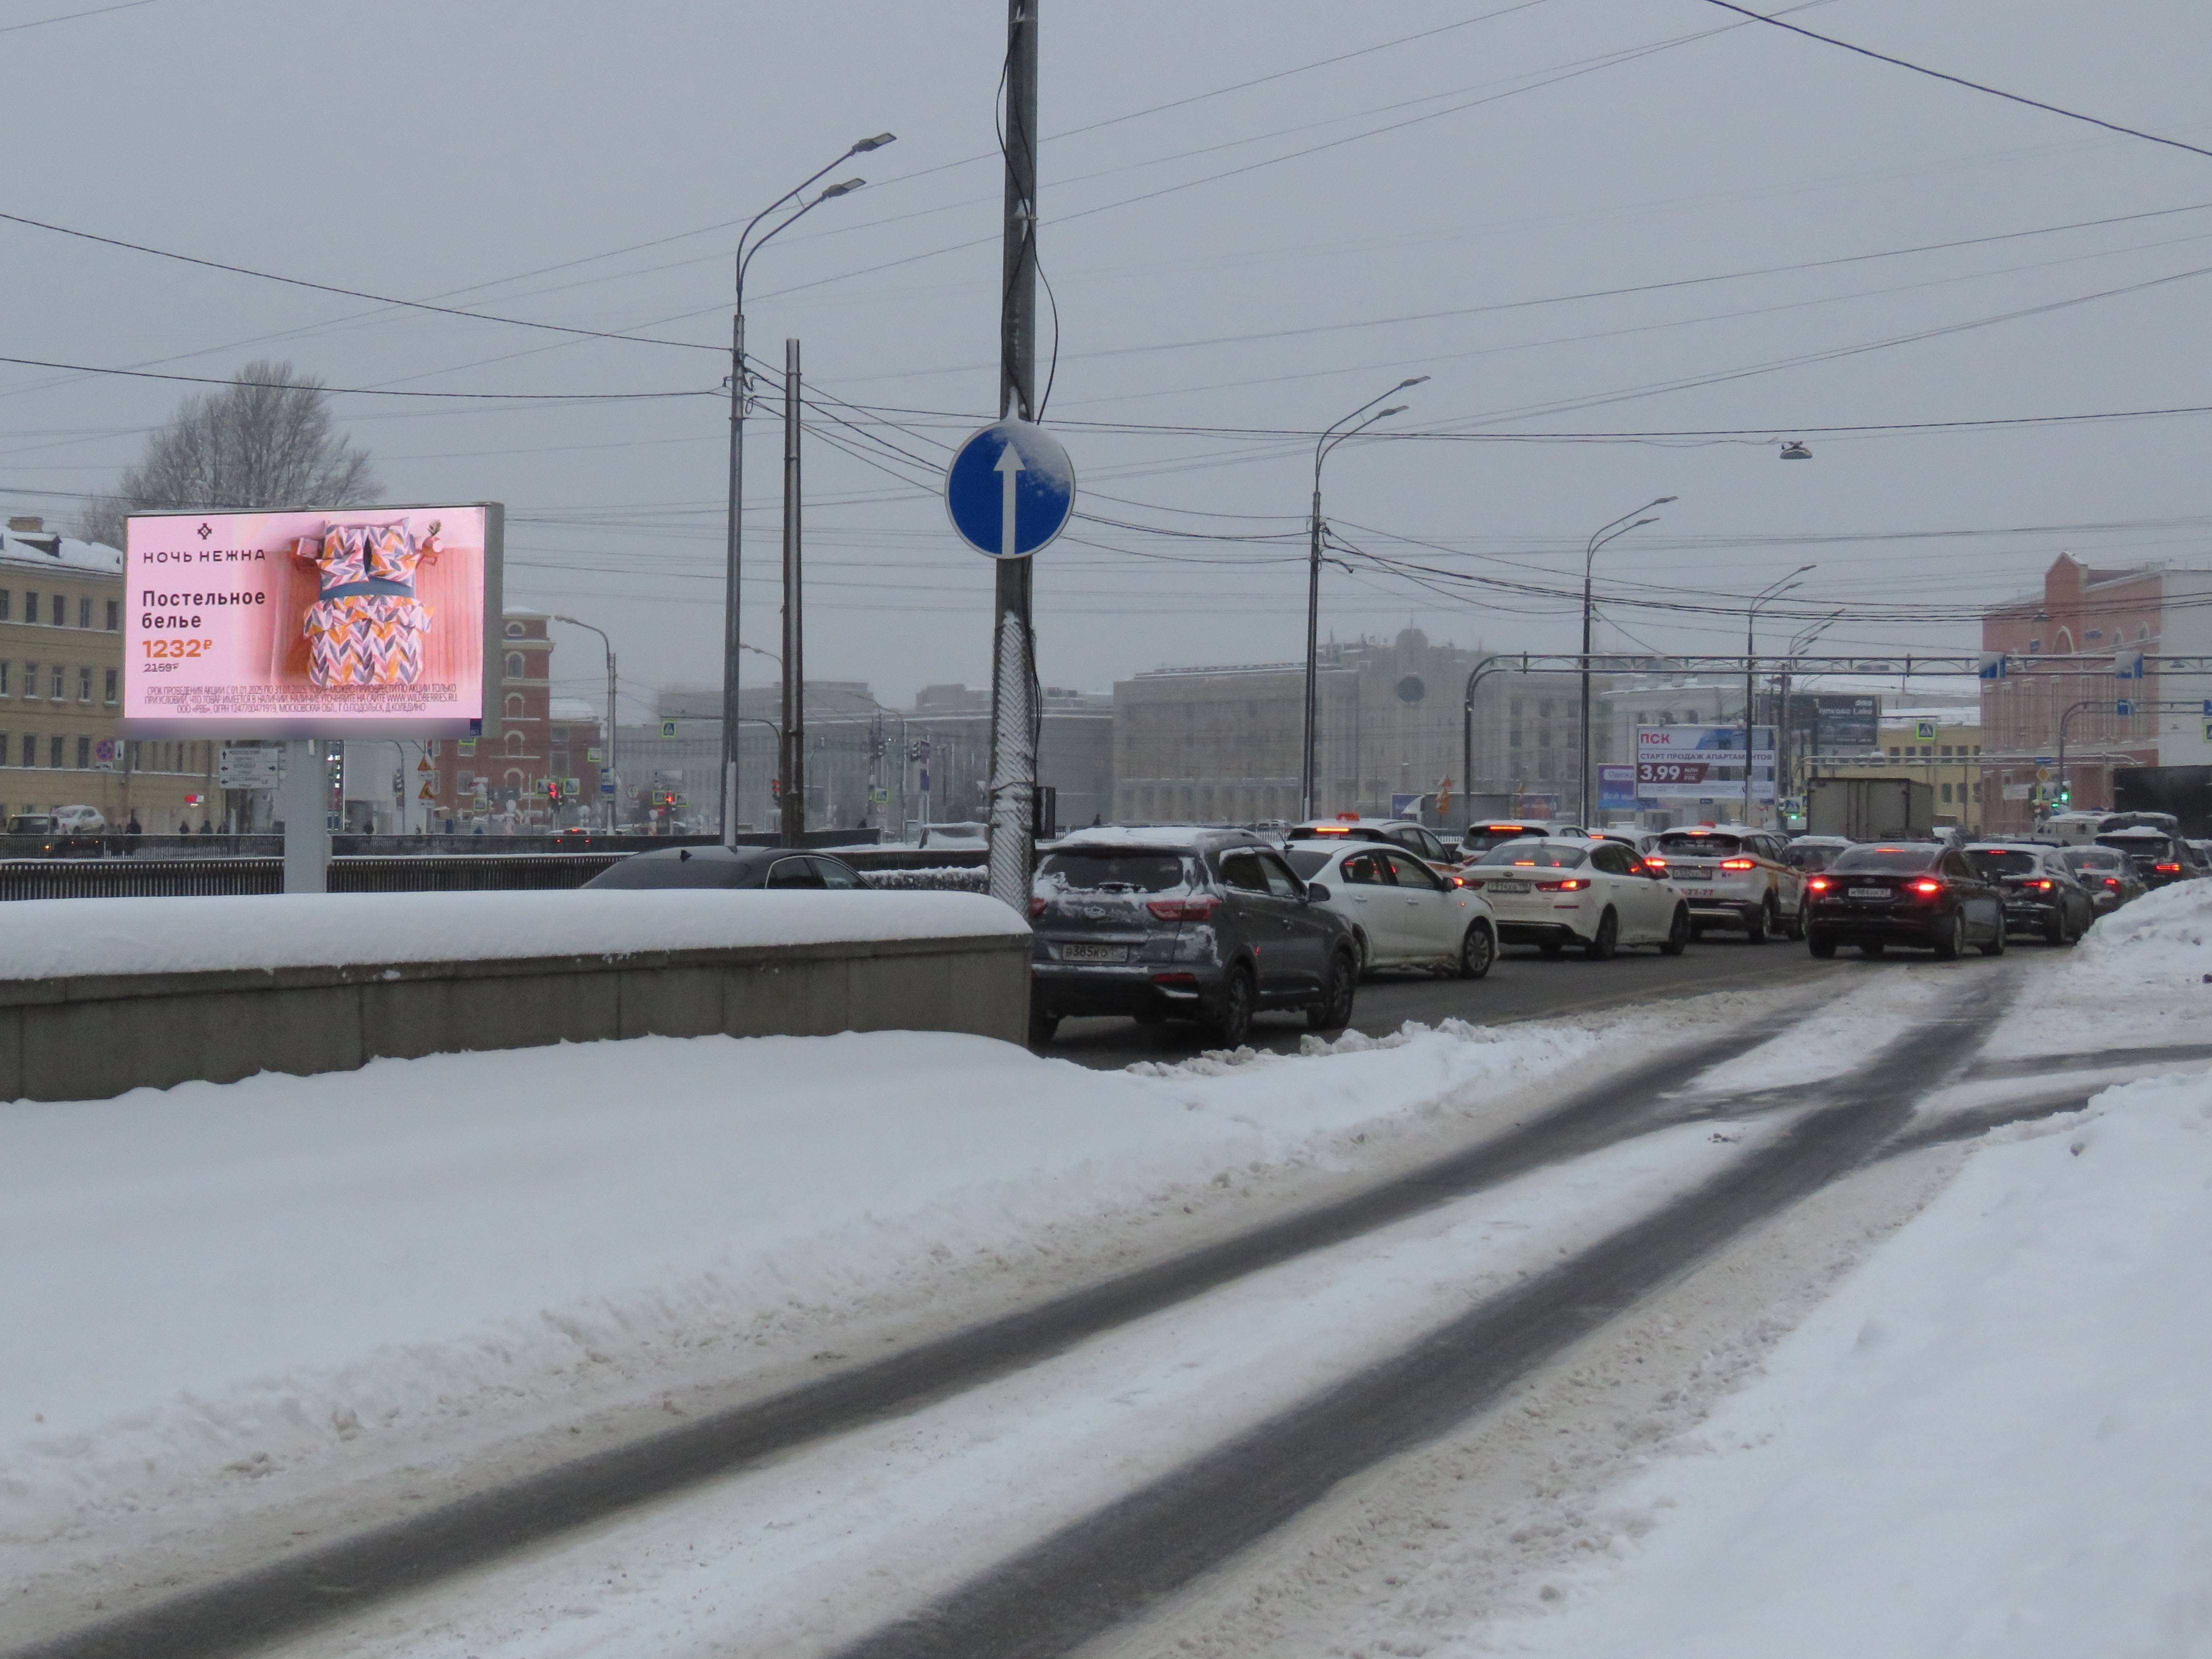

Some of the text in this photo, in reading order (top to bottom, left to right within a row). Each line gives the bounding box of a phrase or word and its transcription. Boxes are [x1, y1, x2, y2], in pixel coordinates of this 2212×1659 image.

[144, 549, 266, 563] НОЧЬ НЕЖНА
[143, 590, 266, 607] Постельное
[142, 613, 202, 628] белье
[147, 686, 162, 695] СРОК
[164, 686, 203, 695] ПРОВЕДЕНИЯ
[204, 686, 225, 695] АКЦИИ
[409, 684, 431, 693] АКЦИИ
[432, 684, 456, 692] ТОЛЬКО
[190, 696, 202, 704] ЧТО
[203, 695, 222, 704] ТОВАР
[223, 695, 251, 704] ИМЕЕТСЯ
[358, 694, 366, 702] НА
[367, 693, 386, 702] САЙТЕ
[177, 704, 191, 713] ООО
[214, 704, 229, 713] ОГРН
[279, 704, 321, 712] МОСКОВСКАЯ
[1640, 734, 1670, 744] ПСК
[1640, 765, 1680, 781] 3,99
